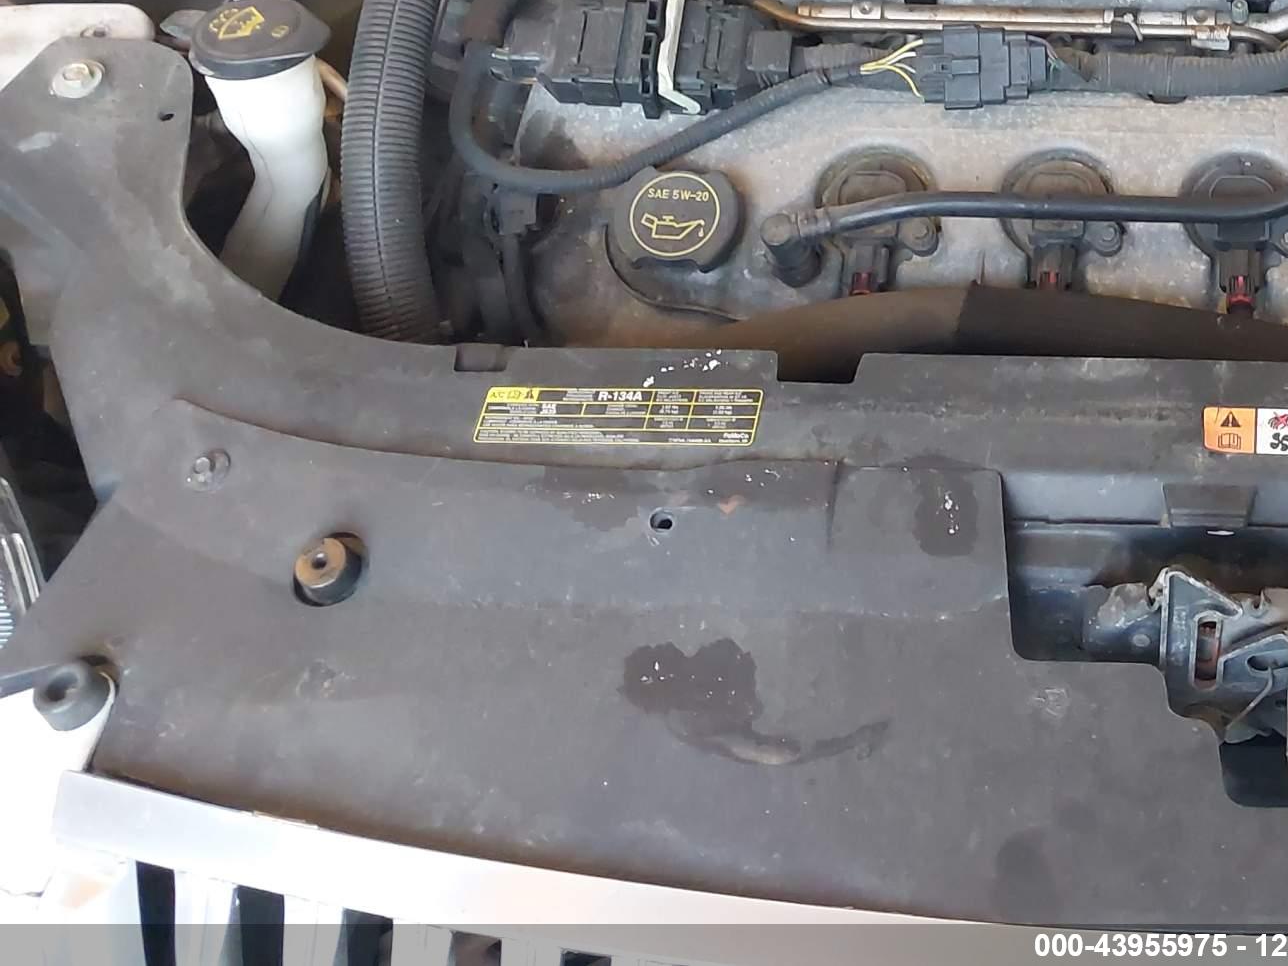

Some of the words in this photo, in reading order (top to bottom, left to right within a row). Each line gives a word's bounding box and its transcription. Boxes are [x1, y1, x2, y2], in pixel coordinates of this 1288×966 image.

[647, 188, 670, 199] SAE
[672, 189, 710, 201] 5W-20
[597, 390, 643, 402] R-134A
